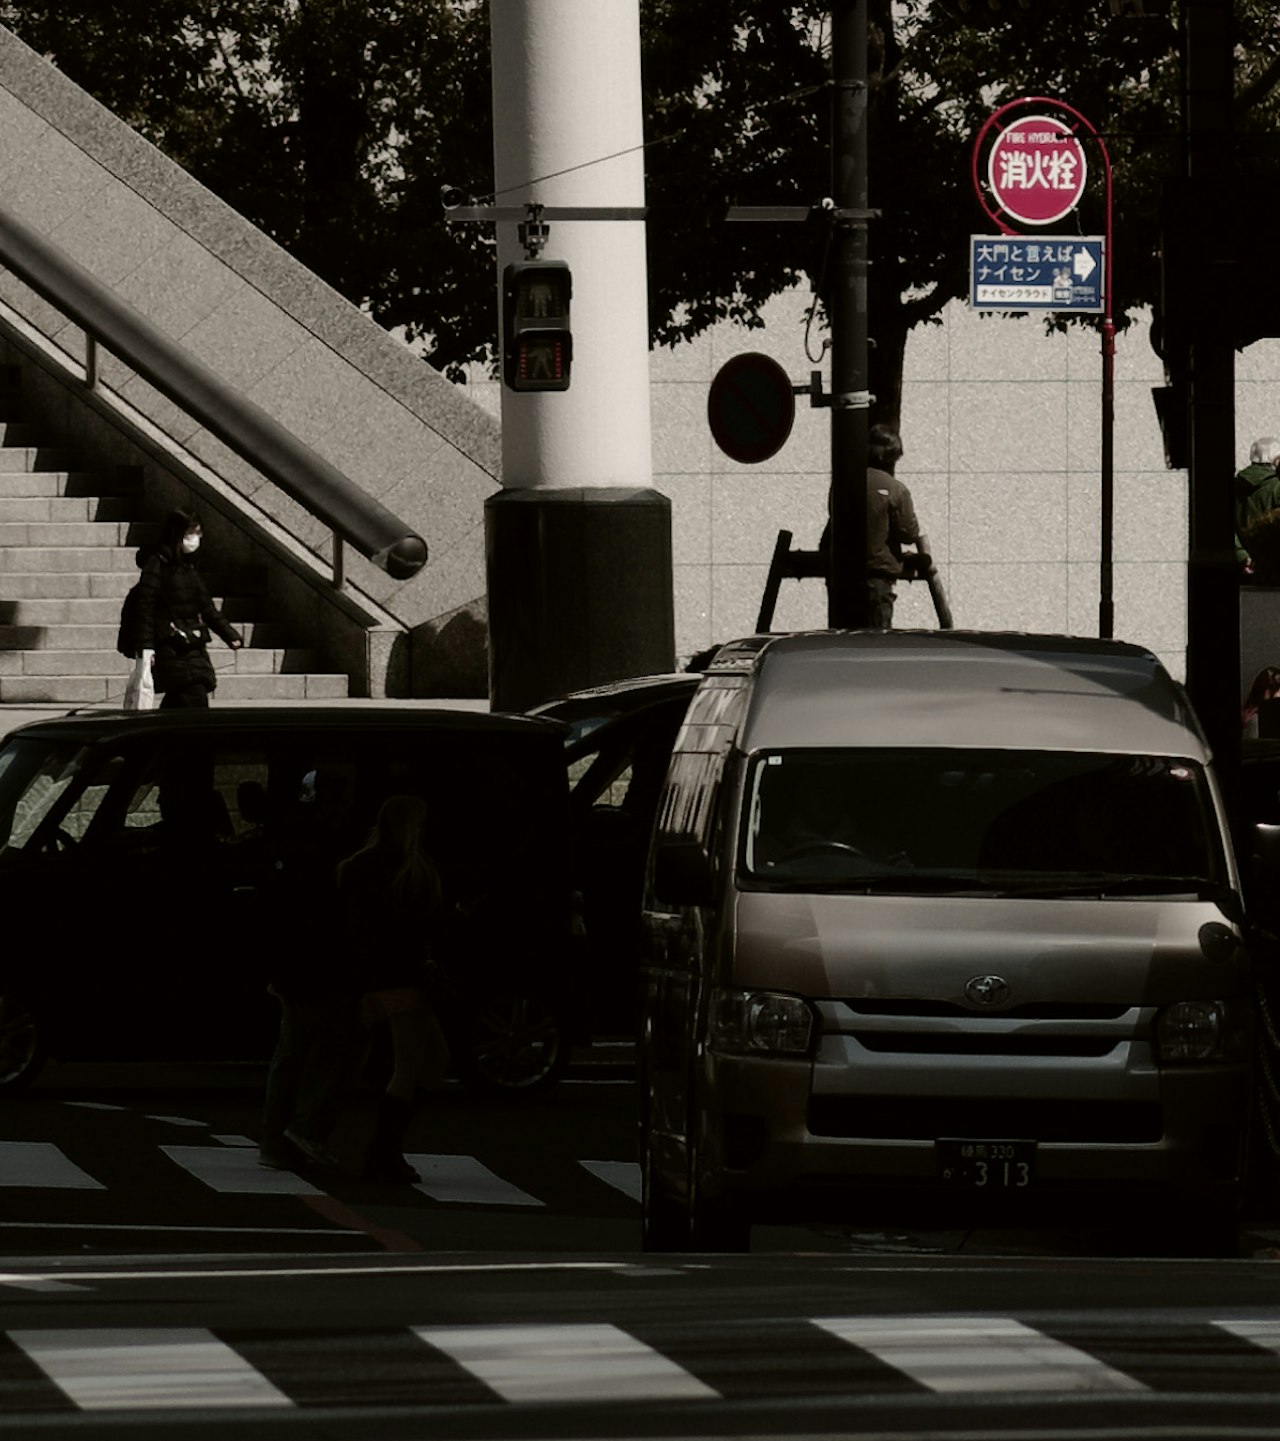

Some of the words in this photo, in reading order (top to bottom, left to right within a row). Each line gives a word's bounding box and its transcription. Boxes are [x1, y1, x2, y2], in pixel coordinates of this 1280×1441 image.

[1005, 131, 1027, 144] FIRE
[999, 149, 1078, 190] 消火栓
[976, 243, 1074, 264] 大門と言えば
[976, 264, 1042, 283] ナイセン
